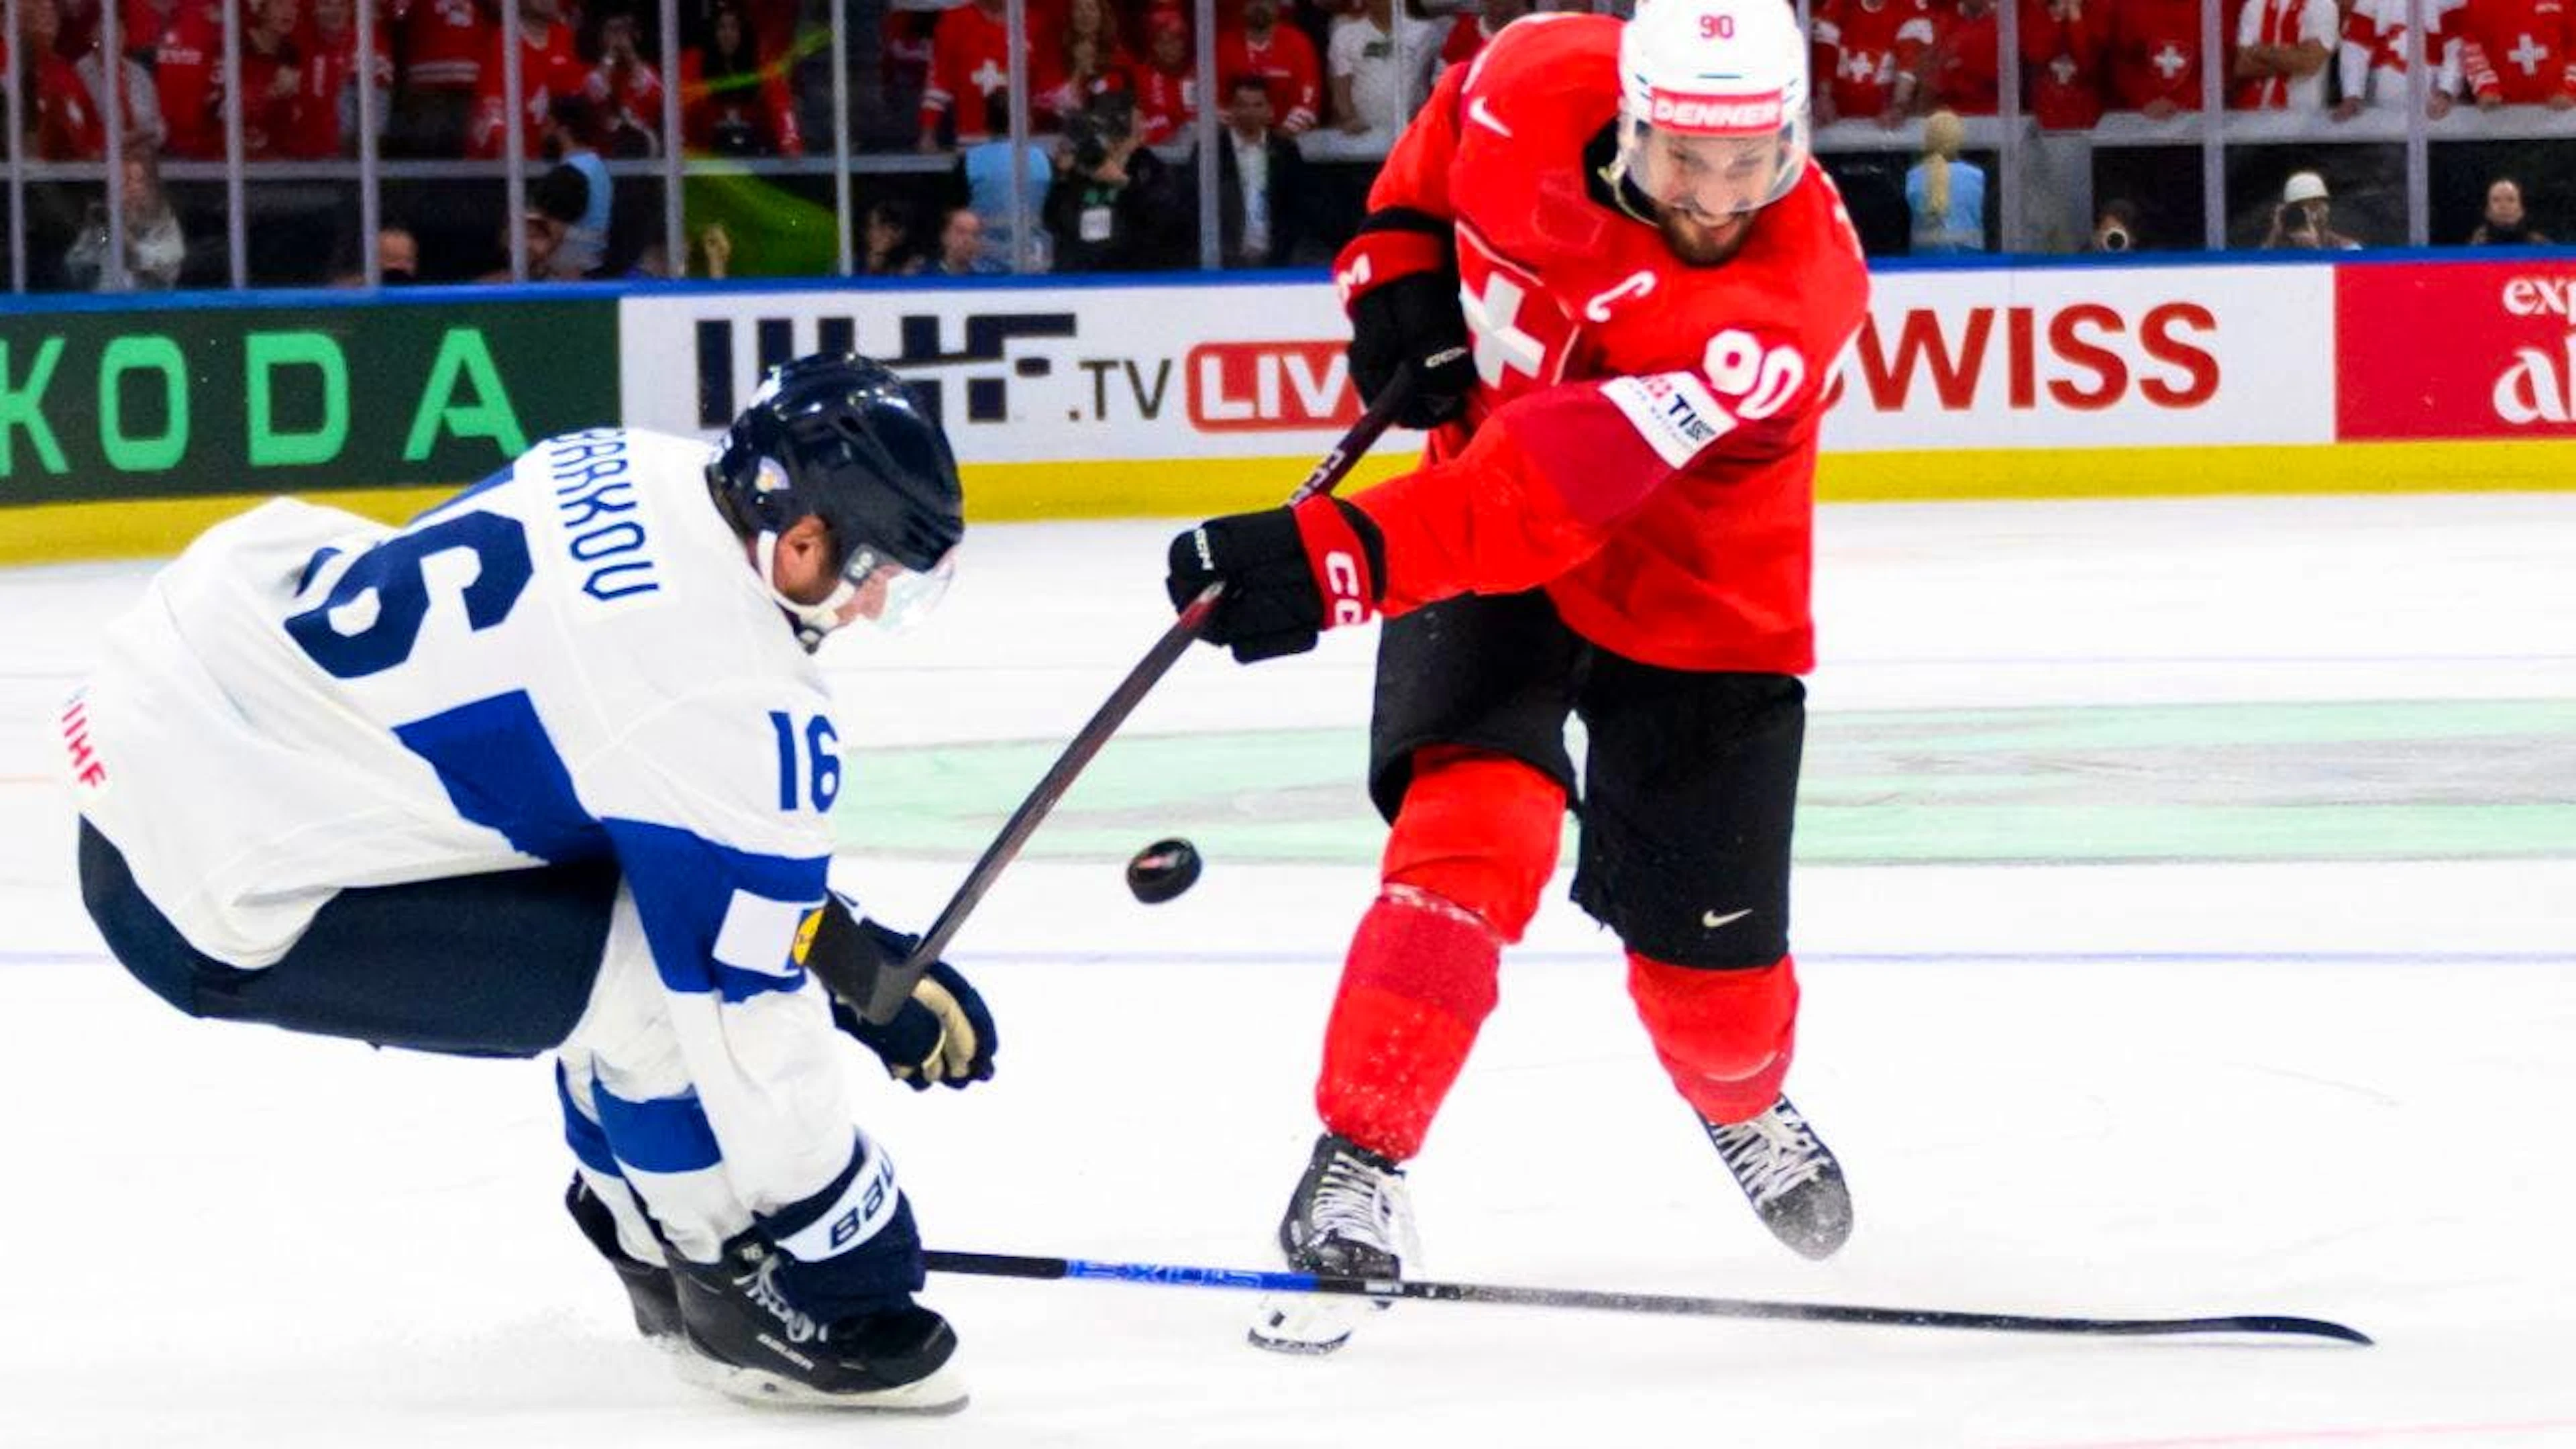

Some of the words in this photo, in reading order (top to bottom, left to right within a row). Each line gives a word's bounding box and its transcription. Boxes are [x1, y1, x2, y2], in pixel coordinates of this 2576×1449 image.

[1700, 15, 1733, 39] 90
[1653, 99, 1779, 128] DENNER
[1586, 270, 1657, 322] C
[2503, 278, 2576, 325] ex
[1199, 352, 1368, 421] LIV
[1819, 302, 2220, 411] WISS
[0, 328, 529, 478] KODA
[549, 428, 660, 602] ARKOV
[769, 710, 841, 813] 16
